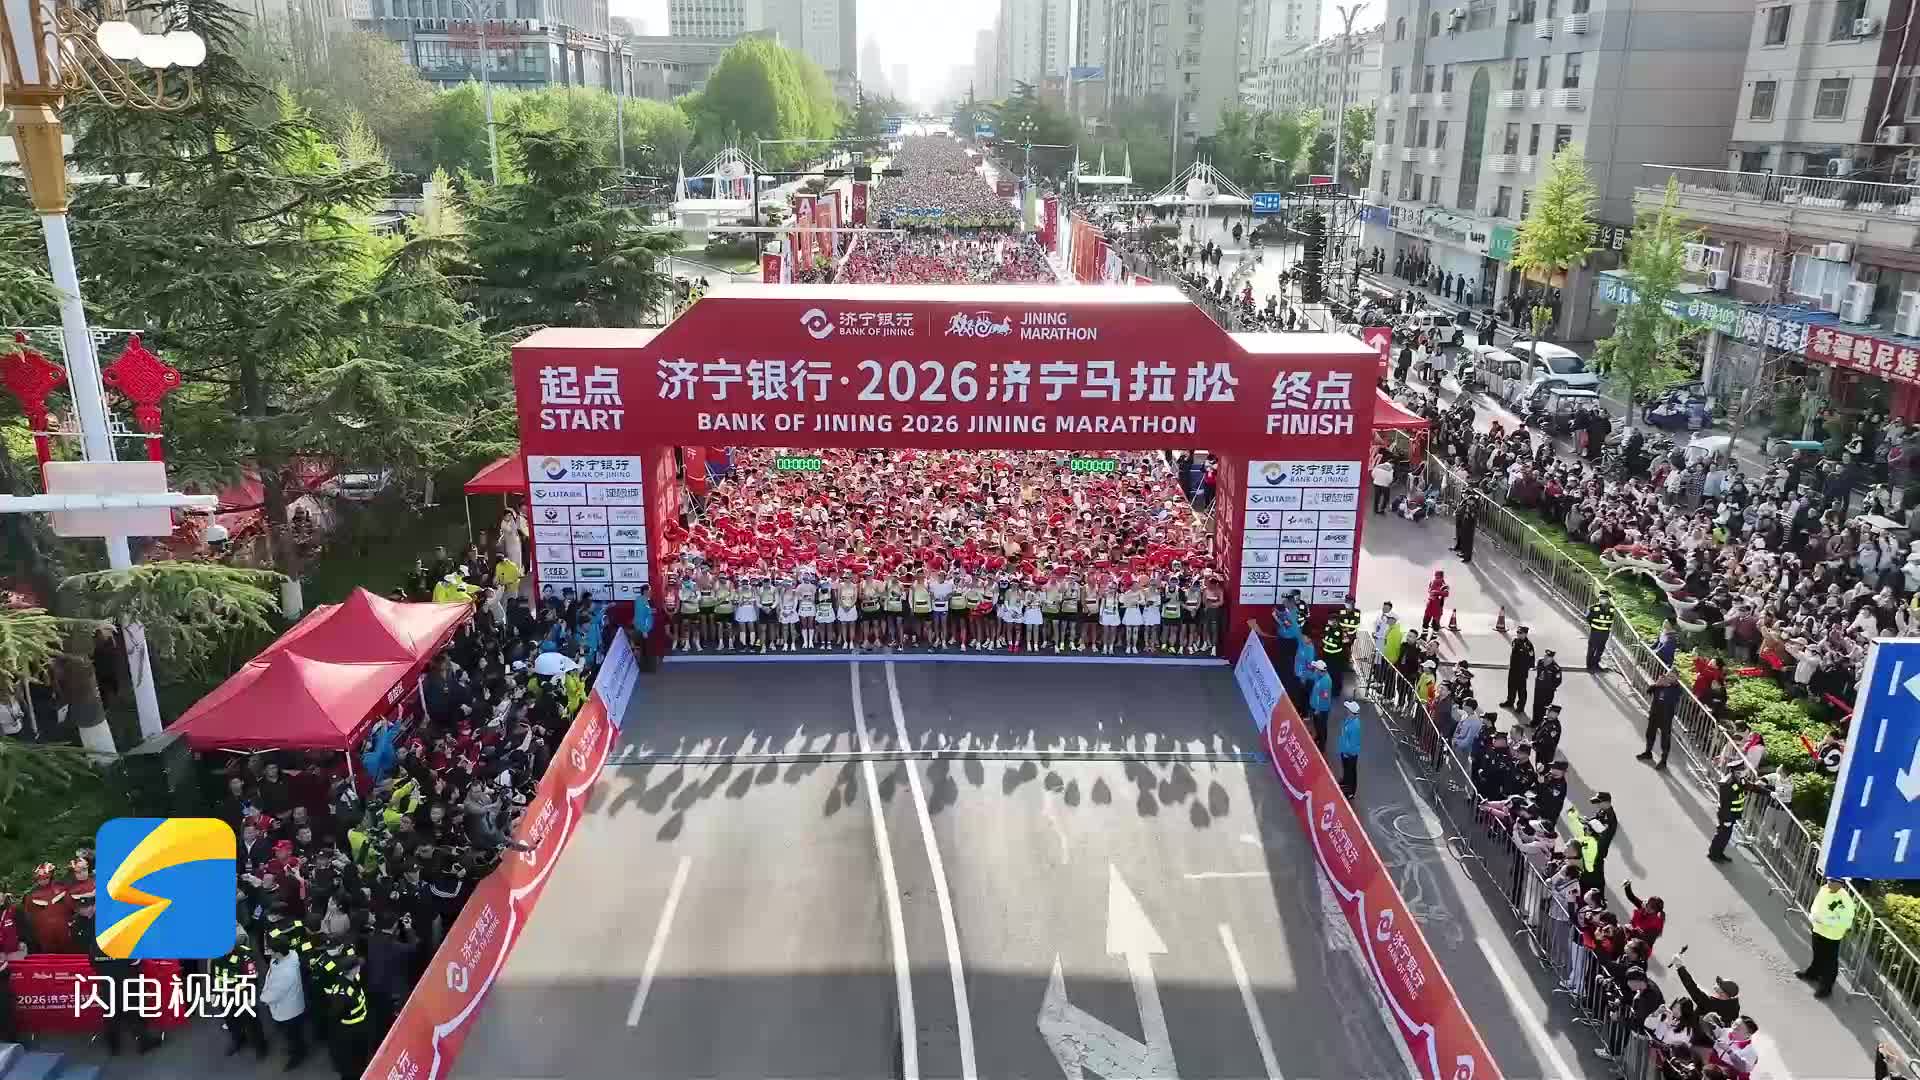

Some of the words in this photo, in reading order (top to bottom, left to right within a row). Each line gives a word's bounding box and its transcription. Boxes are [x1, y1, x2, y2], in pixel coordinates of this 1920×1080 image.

[839, 311, 915, 327] 济宁银行
[1020, 312, 1067, 325] JINING
[839, 327, 866, 337] BANK
[867, 327, 881, 337] OF
[882, 327, 915, 338] JINING
[1020, 327, 1098, 341] MARATHON
[540, 366, 623, 405] 起点
[1271, 370, 1353, 410] 终点
[540, 409, 624, 430] START
[698, 412, 766, 431] BANK
[774, 413, 805, 432] OF
[814, 413, 892, 432] JINING
[902, 414, 960, 433] 2026
[967, 415, 1046, 434] JINING
[1056, 415, 1197, 434] MARATHON
[1266, 414, 1353, 435] FINISH
[571, 459, 630, 471] 济宁银行
[1291, 464, 1350, 476] 济宁银行
[1392, 929, 1426, 990] 济宁银行
[17, 994, 46, 1005] 2026
